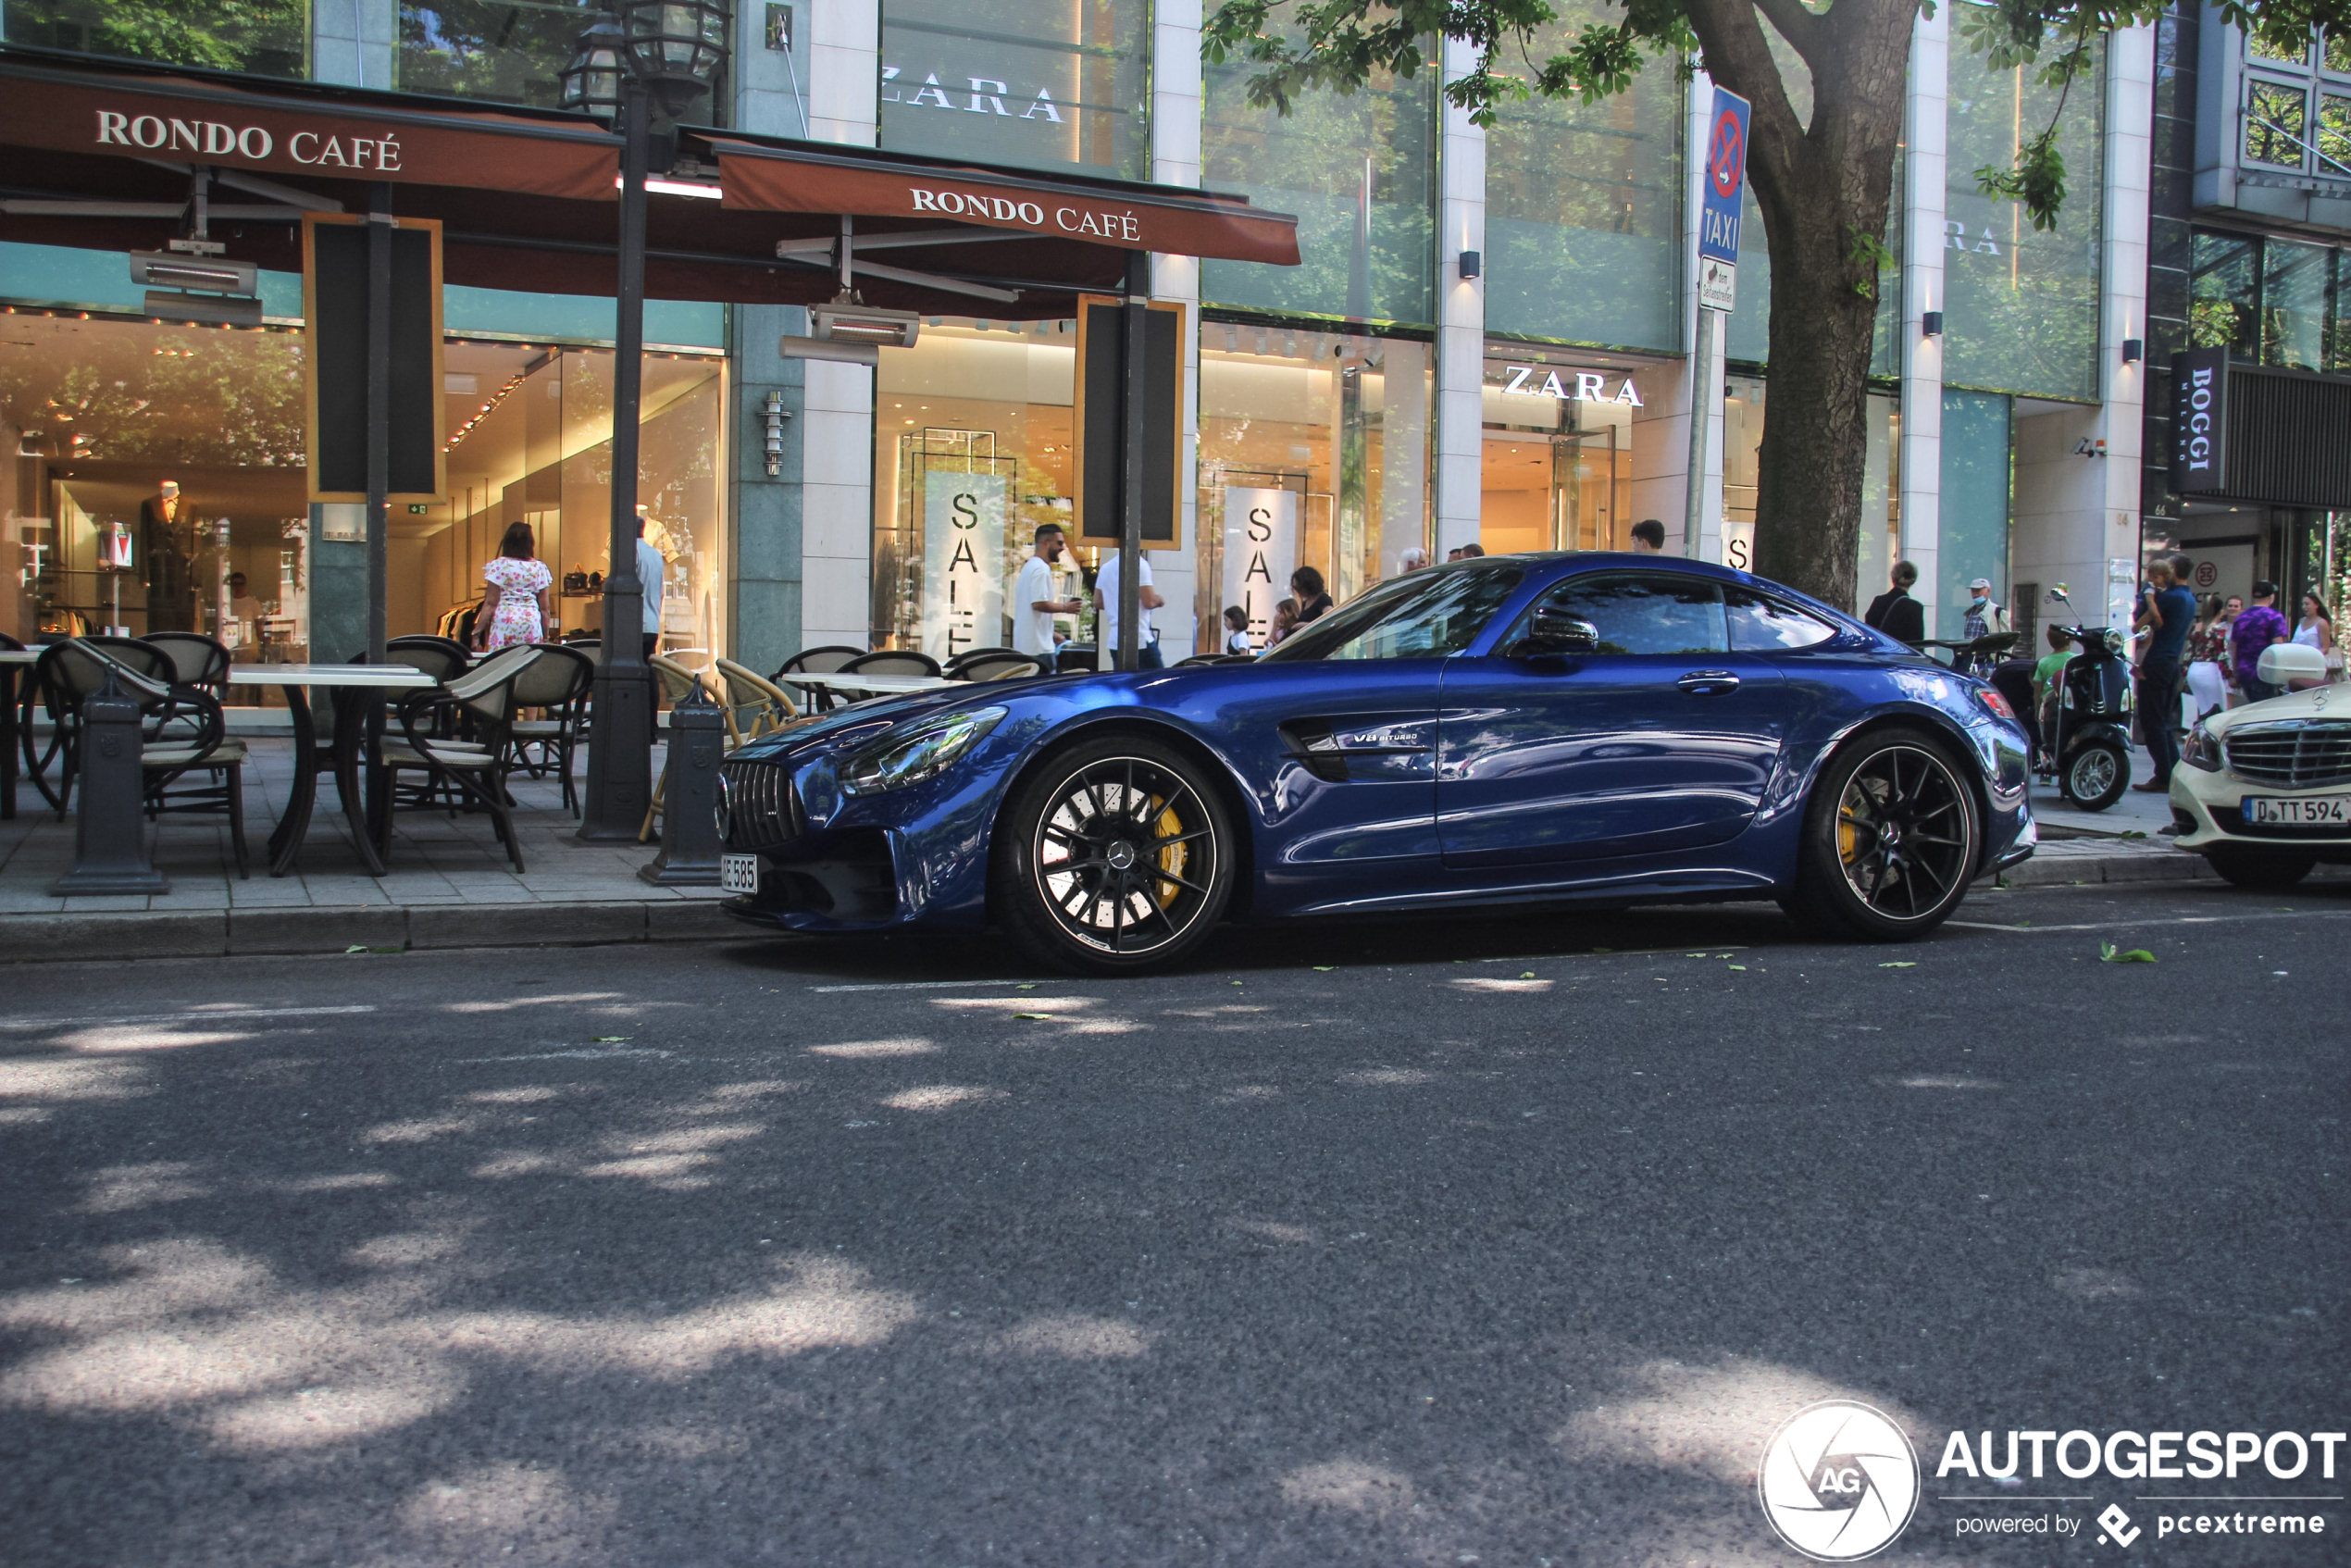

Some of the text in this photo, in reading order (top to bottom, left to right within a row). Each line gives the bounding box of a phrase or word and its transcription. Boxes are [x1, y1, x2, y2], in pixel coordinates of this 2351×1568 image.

[95, 110, 403, 172] RONDO CAFÉ
[909, 188, 1141, 242] RONDO CAFÉ
[1705, 208, 1737, 252] TAXI
[1501, 365, 1645, 407] ZARA
[2179, 381, 2188, 461] MILANO
[2189, 367, 2212, 472] BOGGI
[2155, 504, 2166, 516] 66
[949, 492, 979, 658] SALE
[1353, 734, 1376, 742] V8
[2278, 801, 2300, 821] TT
[2304, 801, 2343, 821] 594
[734, 859, 755, 889] 585
